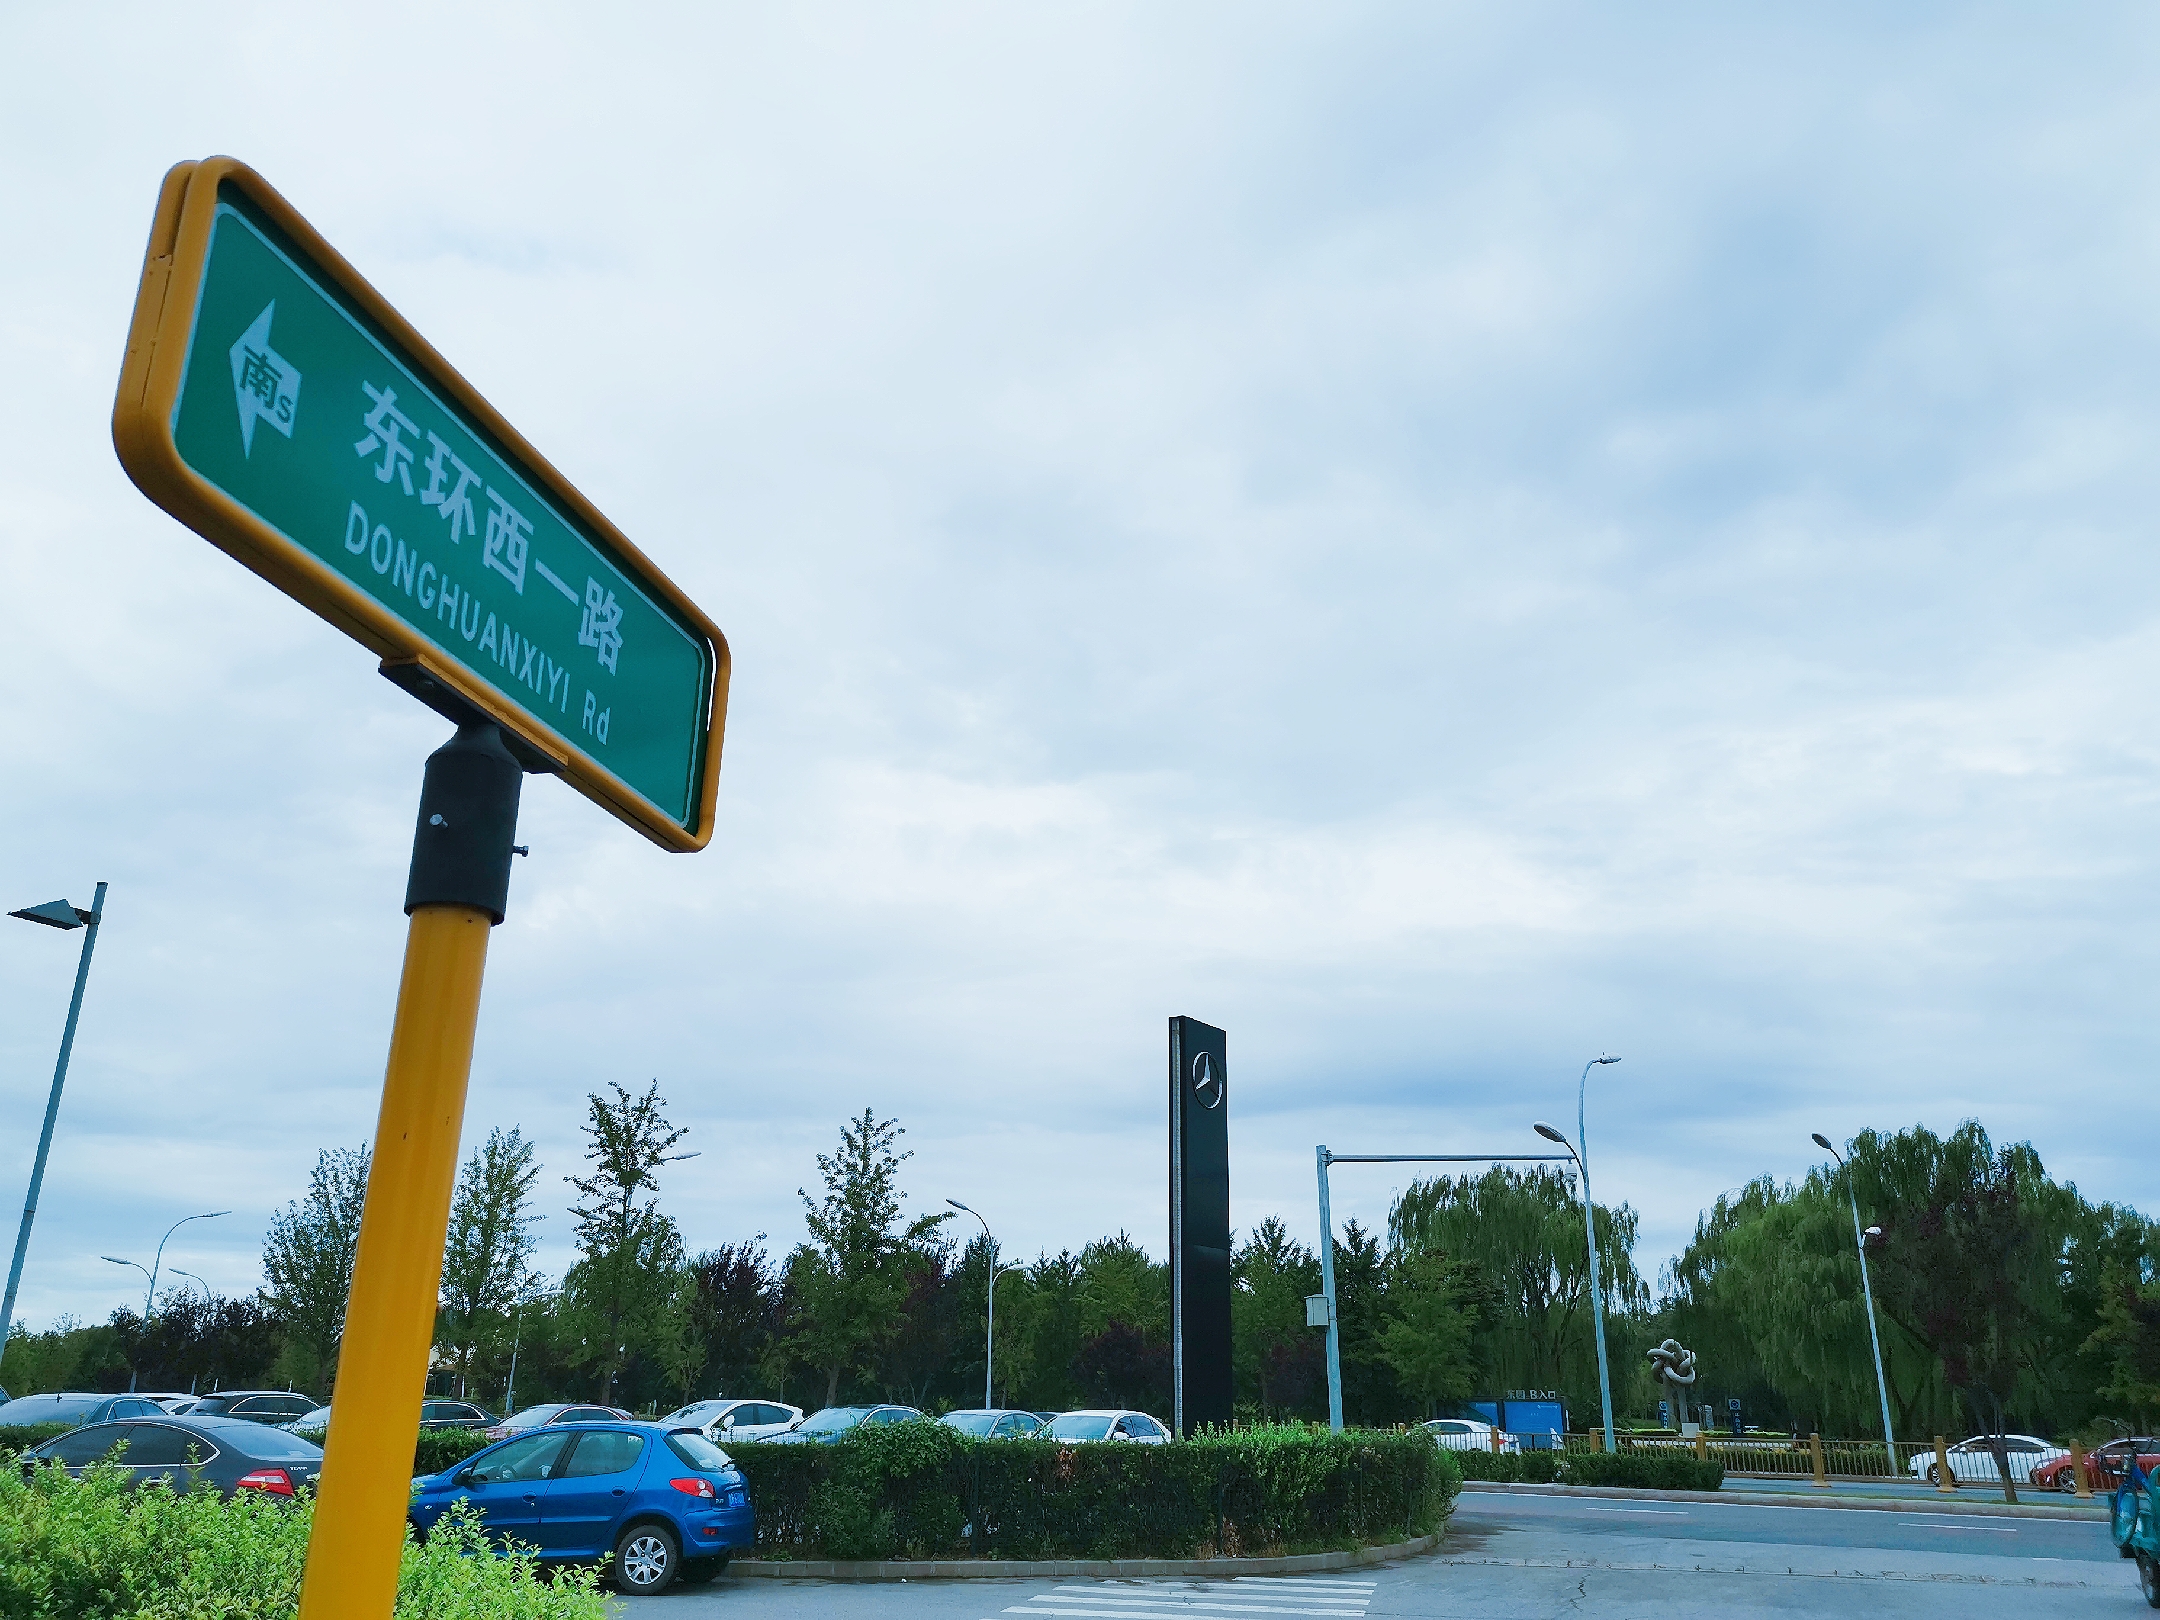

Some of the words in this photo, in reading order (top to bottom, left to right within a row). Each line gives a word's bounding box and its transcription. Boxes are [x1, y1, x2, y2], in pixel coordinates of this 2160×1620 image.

[344, 499, 570, 713] DONGHUANXIYI
[582, 689, 611, 745] Rd
[354, 380, 624, 676] 东环西一路
